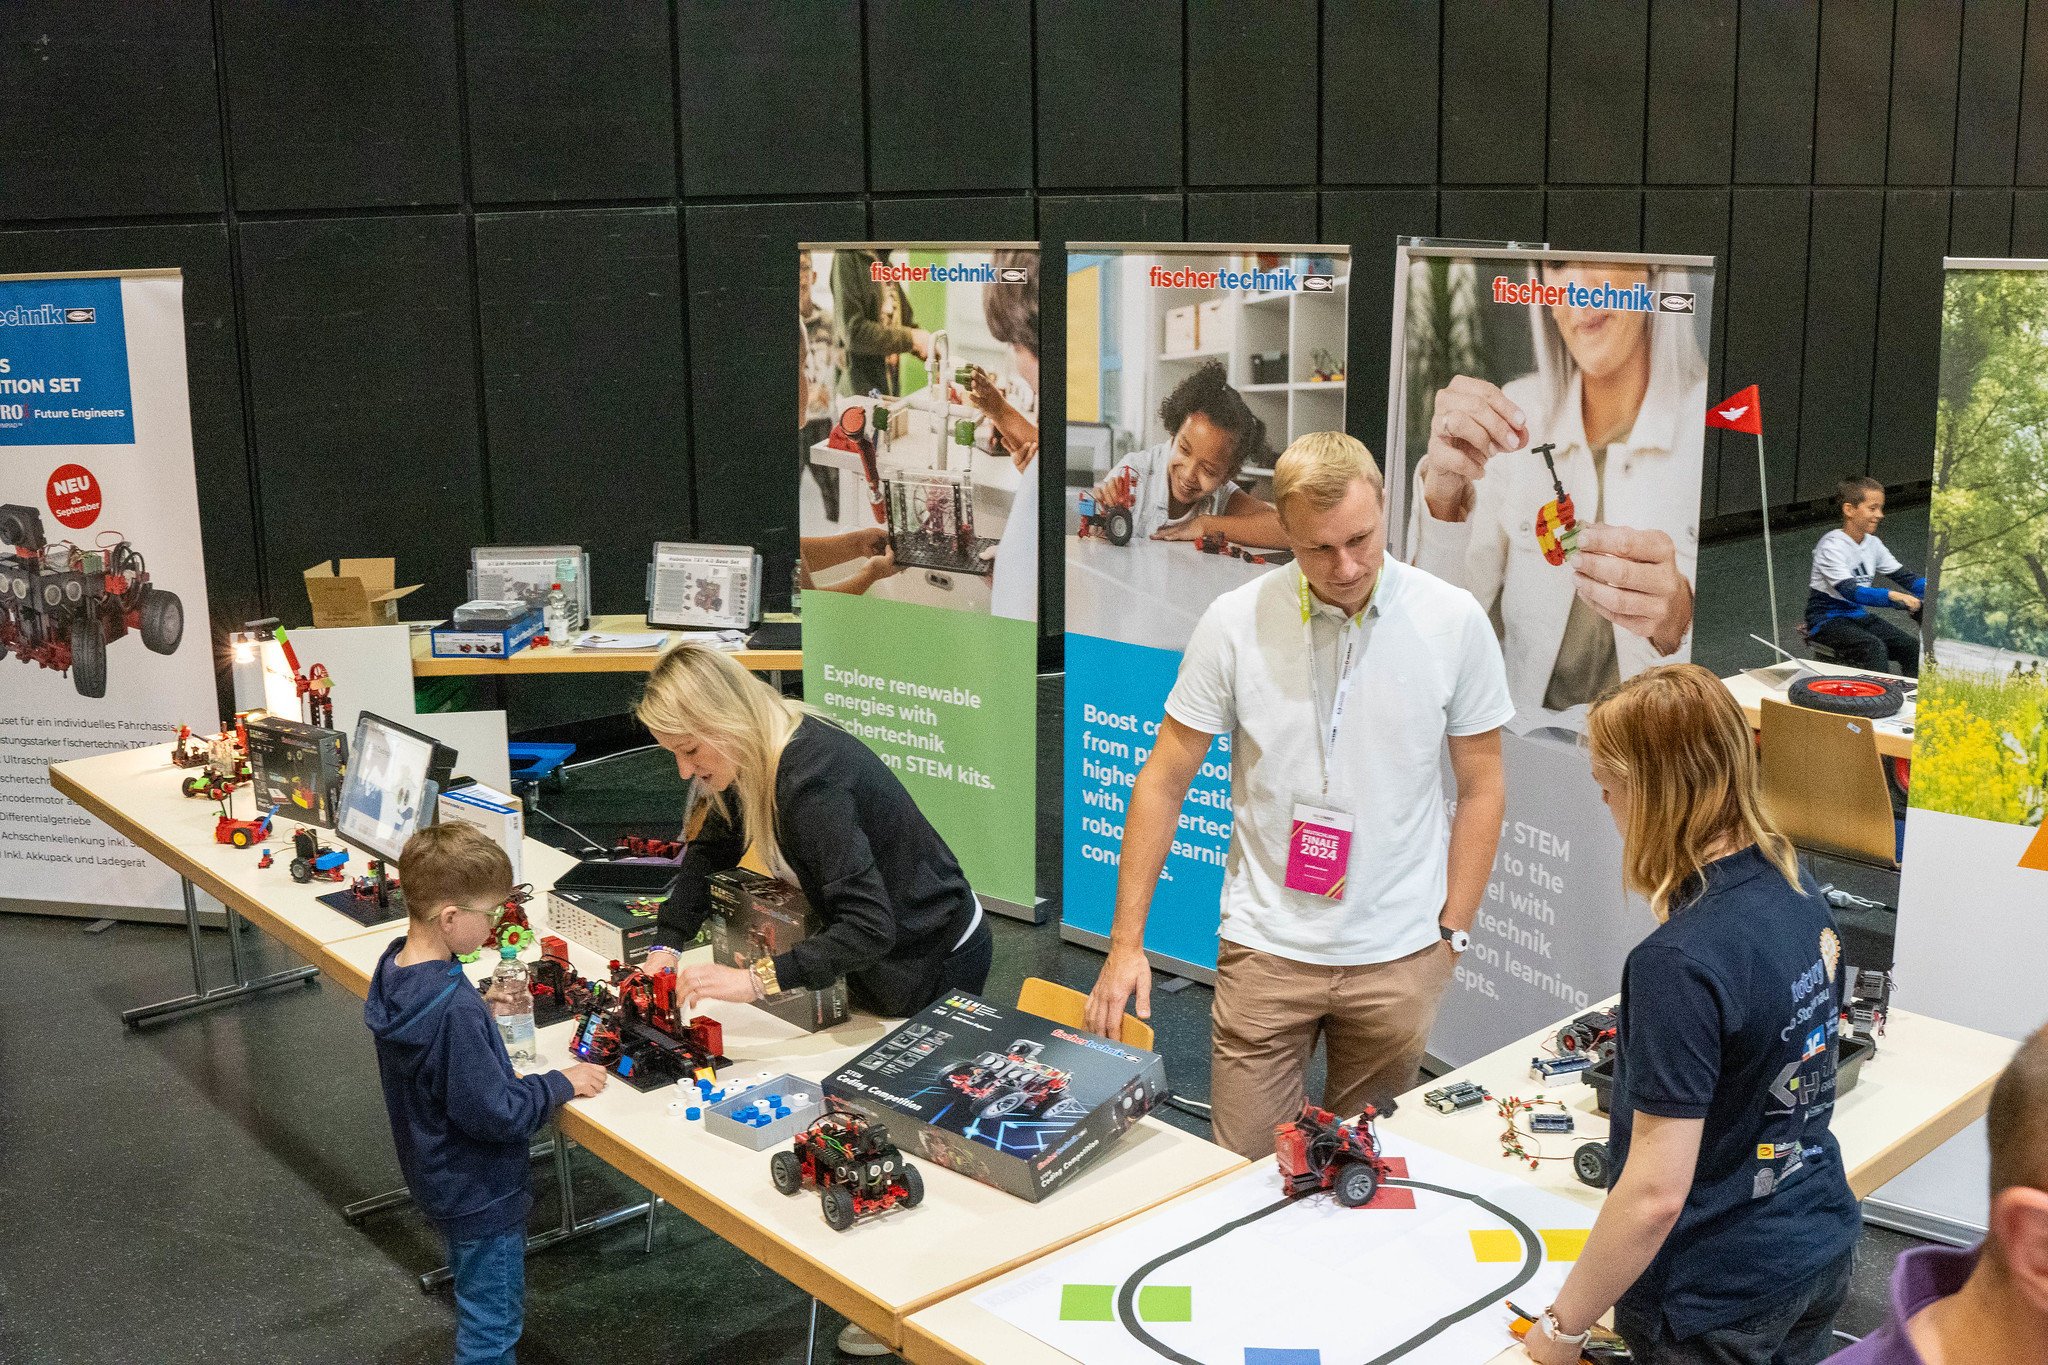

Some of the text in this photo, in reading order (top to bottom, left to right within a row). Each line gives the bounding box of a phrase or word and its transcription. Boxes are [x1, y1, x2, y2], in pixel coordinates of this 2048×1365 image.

[870, 262, 999, 284] fischertechnik
[1150, 265, 1297, 291] fischertechnik
[1492, 276, 1655, 313] fischertechnik
[49, 377, 82, 393] SET
[34, 409, 69, 419] Future
[71, 408, 125, 420] Engineers
[53, 475, 91, 497] NEU
[56, 502, 100, 518] September
[70, 496, 82, 505] ab
[823, 664, 981, 709] Explore renewable
[824, 692, 937, 726] energies with
[1084, 704, 1138, 733] Boost
[21, 717, 33, 726] für
[37, 718, 52, 727] ein
[54, 718, 116, 729] individuelles
[118, 721, 176, 732] Fahrchassis
[832, 712, 945, 753] chertechnik
[0, 737, 61, 747] stungsstarker
[63, 738, 128, 750] fischertechnik
[1083, 731, 1129, 759] from
[906, 755, 952, 780] STEM
[958, 765, 995, 789] kits.
[1083, 758, 1137, 787] highe
[1082, 789, 1124, 813] with
[0, 812, 91, 826] Differentialgetriebe
[2, 831, 105, 848] Achsschenkellenkung
[108, 837, 128, 847] inkl.
[1300, 843, 1337, 861] 2024
[1302, 834, 1340, 850] FINALE
[1514, 821, 1570, 862] STEM
[4, 851, 146, 868] Inkl. Akkupack und Ladegerät
[1503, 851, 1524, 877] to
[1529, 862, 1564, 894] the
[1510, 891, 1555, 926] with
[1505, 950, 1589, 1011] learning
[1050, 1028, 1124, 1059] fischertechnik
[844, 1069, 864, 1079] STEM
[836, 1074, 869, 1091] Coding
[867, 1086, 922, 1112] Competition
[1041, 1139, 1100, 1188] Coding Competition
